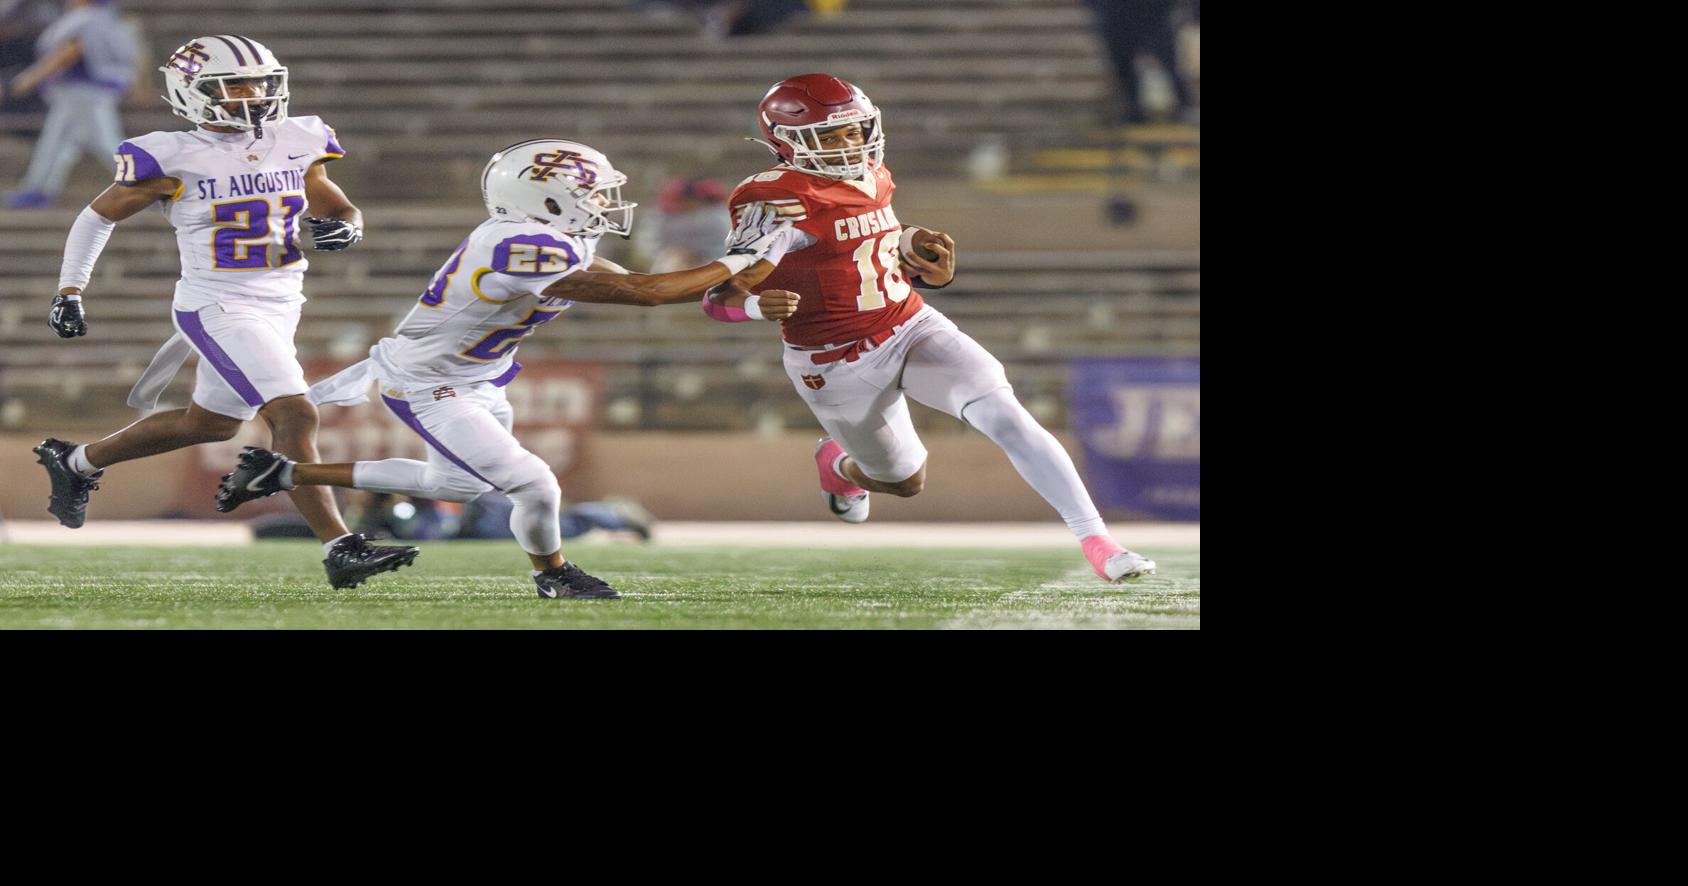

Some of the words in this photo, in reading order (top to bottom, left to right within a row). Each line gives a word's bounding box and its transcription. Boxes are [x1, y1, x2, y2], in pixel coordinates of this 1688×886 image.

[198, 179, 223, 200] ST.
[210, 193, 304, 270] 21
[506, 243, 569, 273] 23
[852, 229, 911, 312] 18
